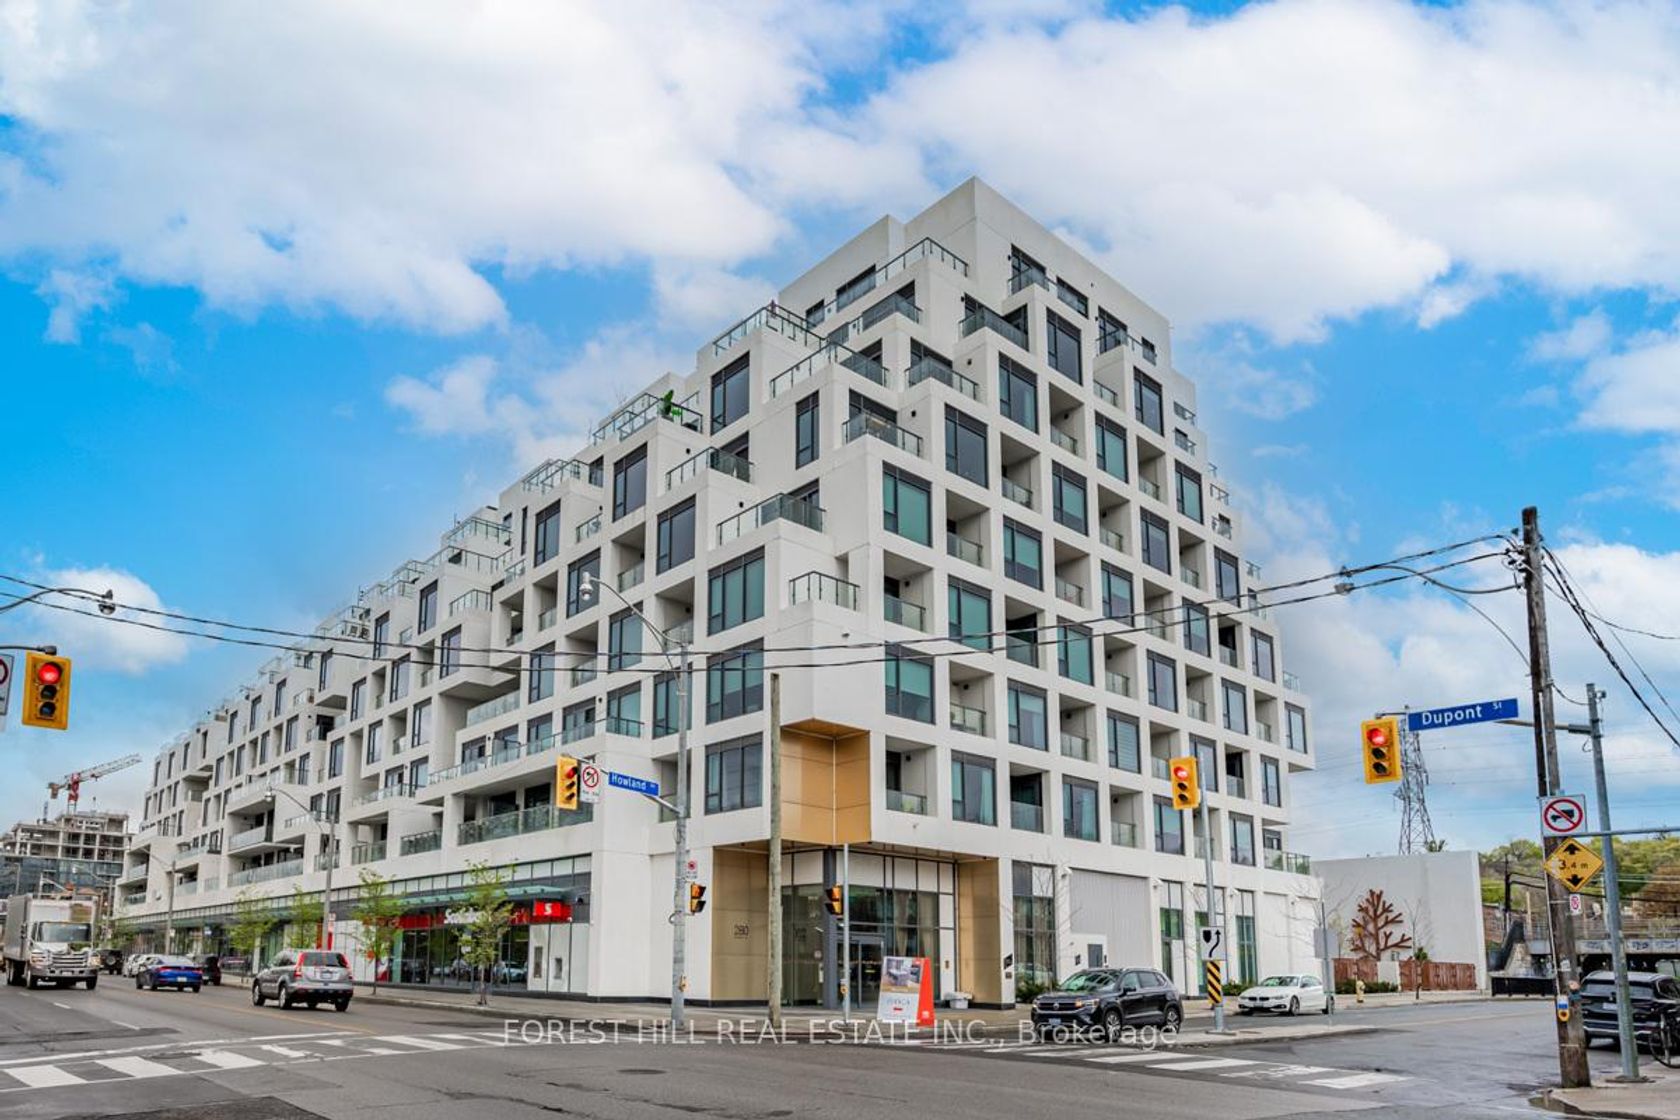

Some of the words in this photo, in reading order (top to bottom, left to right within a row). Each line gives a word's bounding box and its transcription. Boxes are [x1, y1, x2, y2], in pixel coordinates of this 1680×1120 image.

[1422, 705, 1482, 725] Dupont
[1493, 702, 1502, 710] St
[611, 774, 647, 790] Howland
[1559, 859, 1577, 870] 3.4
